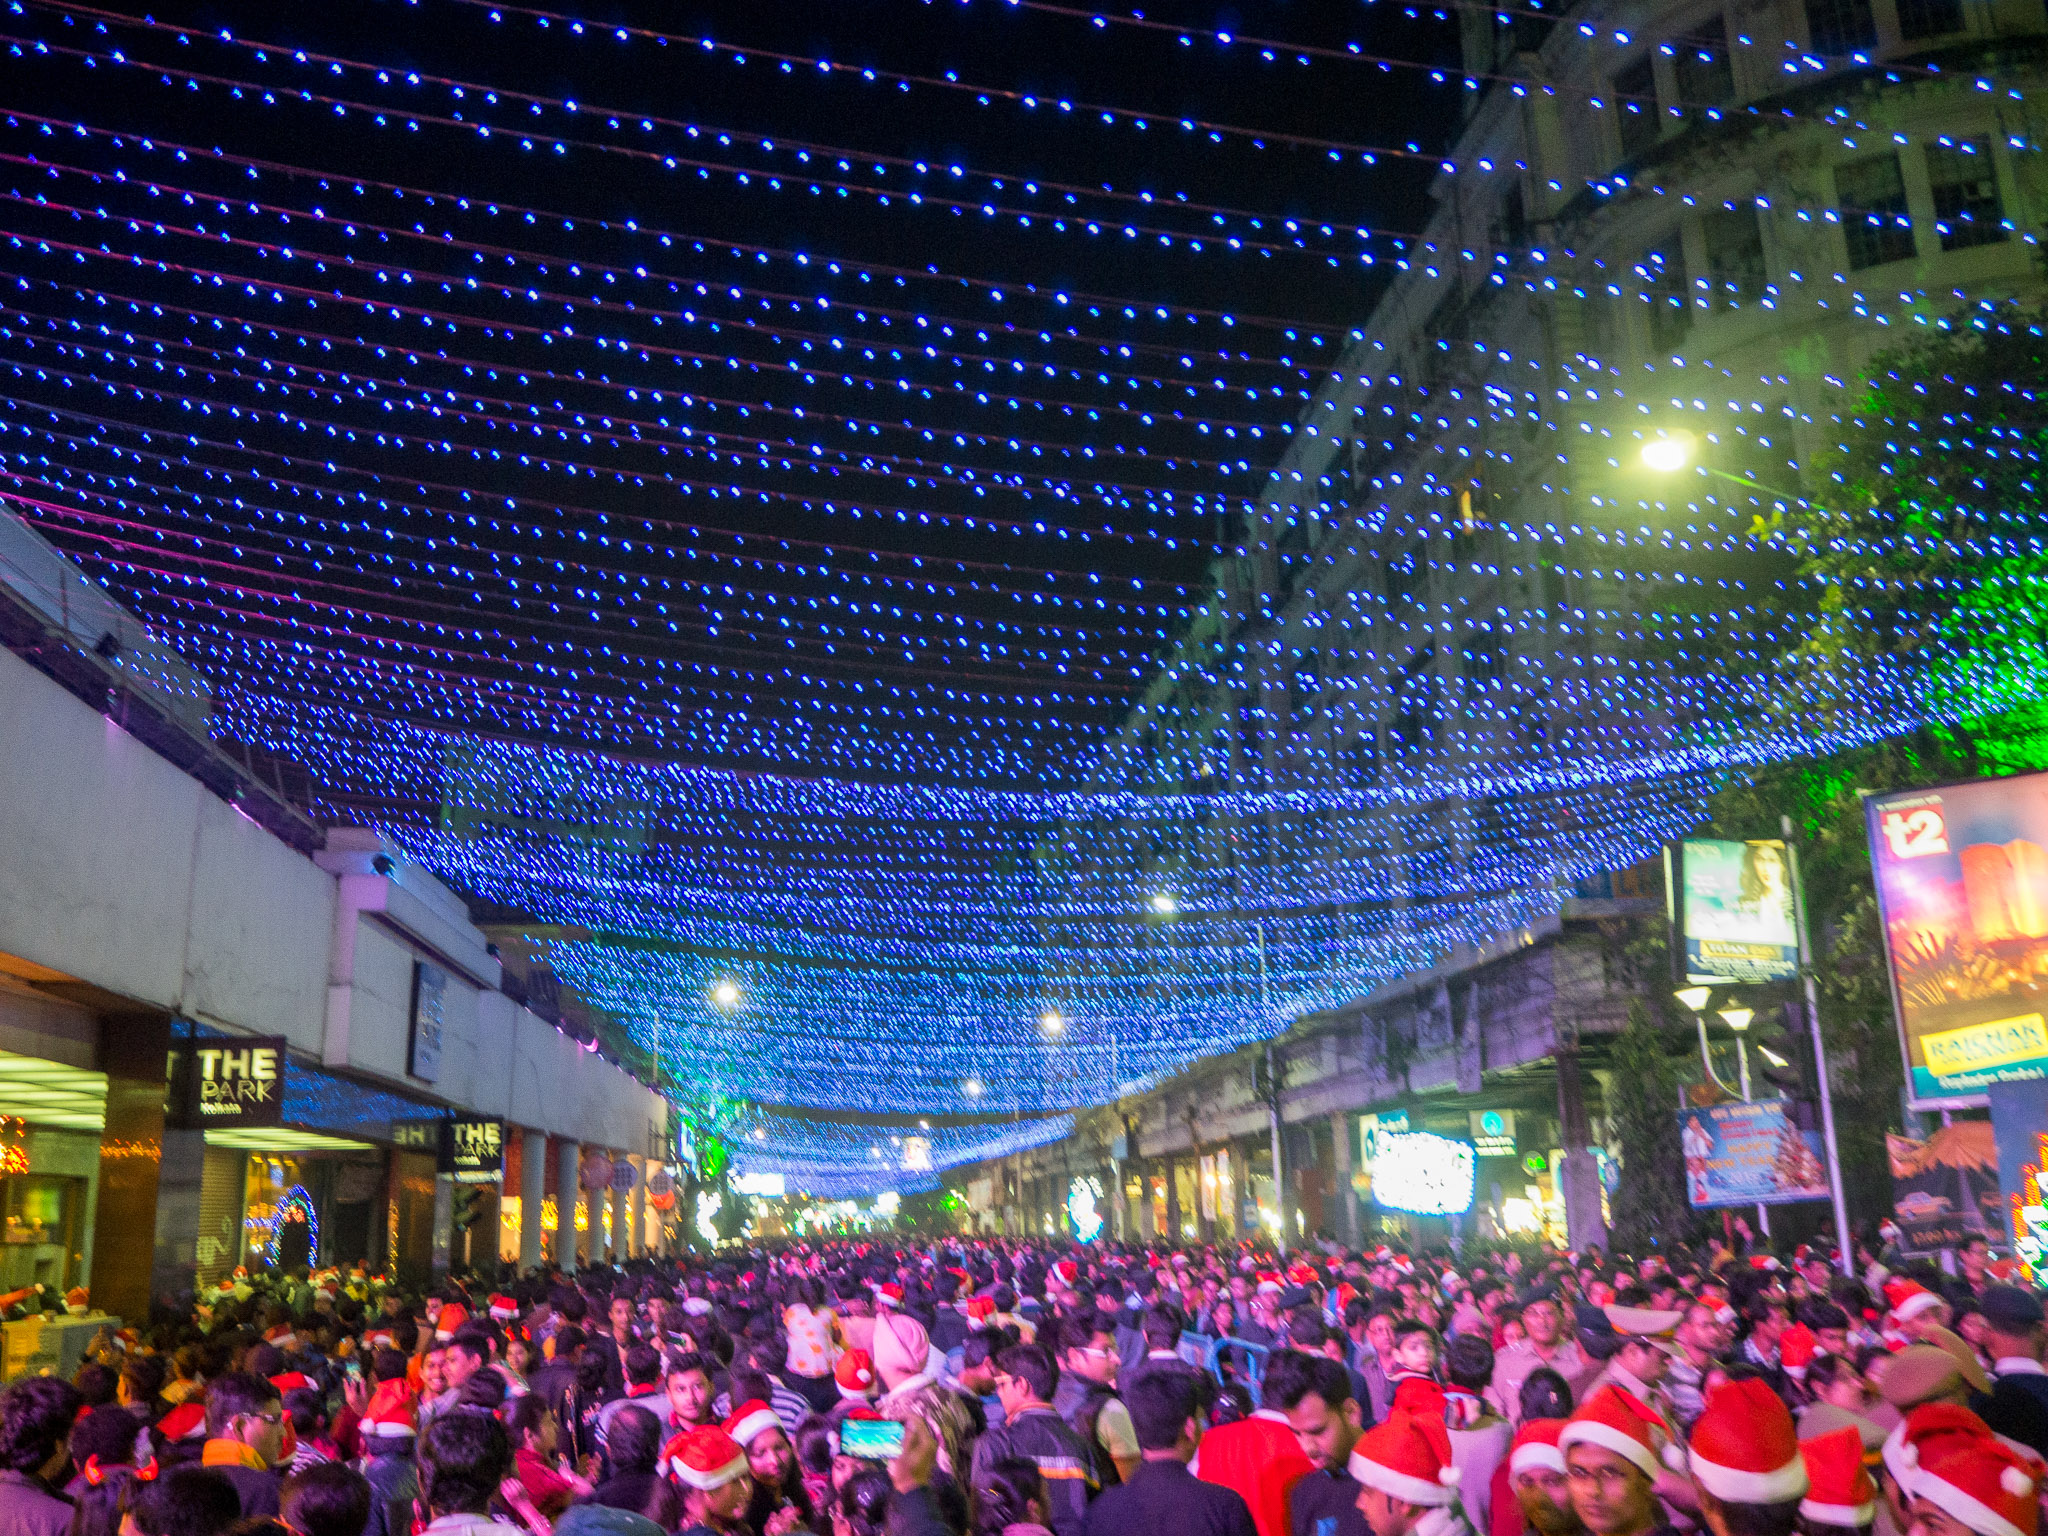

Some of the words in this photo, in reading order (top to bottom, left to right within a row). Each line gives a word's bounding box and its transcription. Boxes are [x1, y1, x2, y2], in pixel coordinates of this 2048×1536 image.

[1882, 810, 1949, 859] t2
[197, 1048, 278, 1080] THE
[201, 1080, 275, 1102] PARK
[453, 1122, 501, 1145] THE
[454, 1143, 500, 1158] PARK
